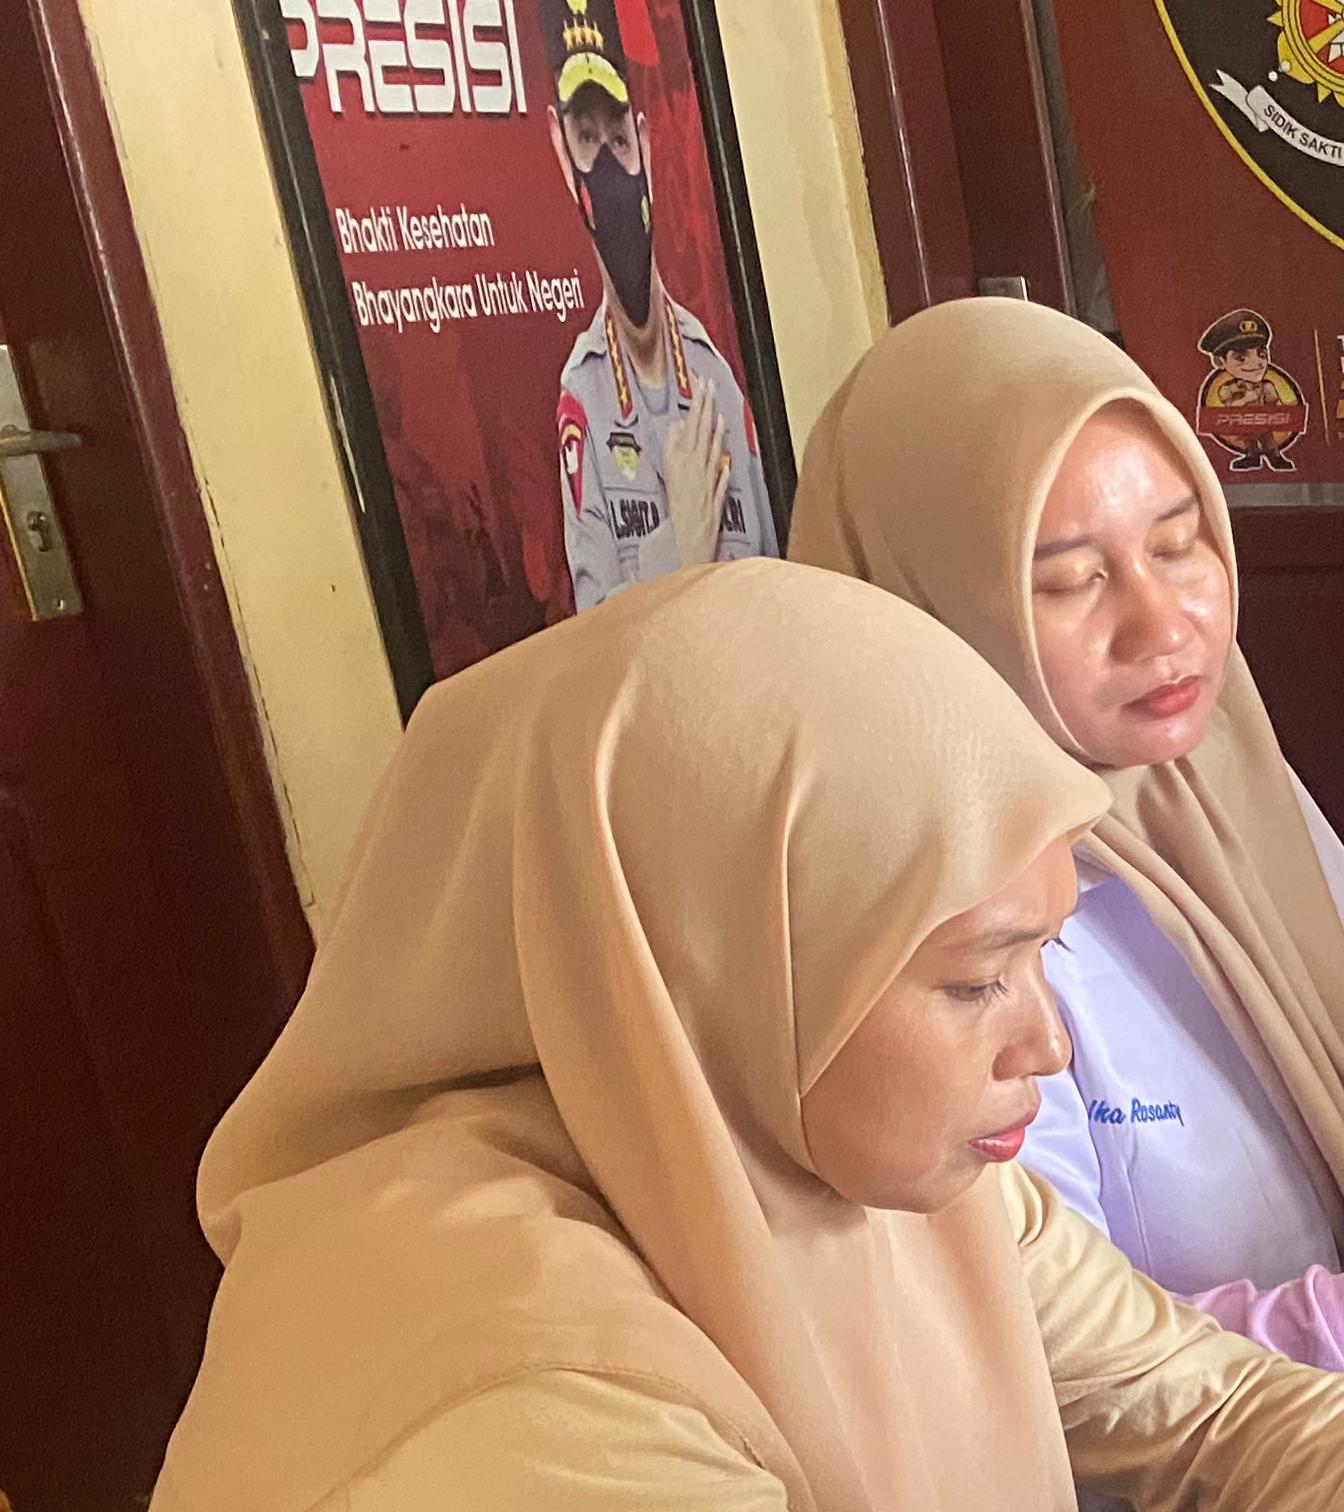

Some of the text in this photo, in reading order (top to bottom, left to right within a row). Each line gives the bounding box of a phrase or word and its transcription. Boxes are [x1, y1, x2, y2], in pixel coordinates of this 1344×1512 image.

[1264, 104, 1297, 139] SIDIK
[1300, 133, 1342, 158] SAKTI
[336, 204, 495, 253] Bhakti Kesehatan
[352, 269, 585, 333] Bhayangkara Untuk Negeri
[1216, 413, 1291, 426] PRESISI
